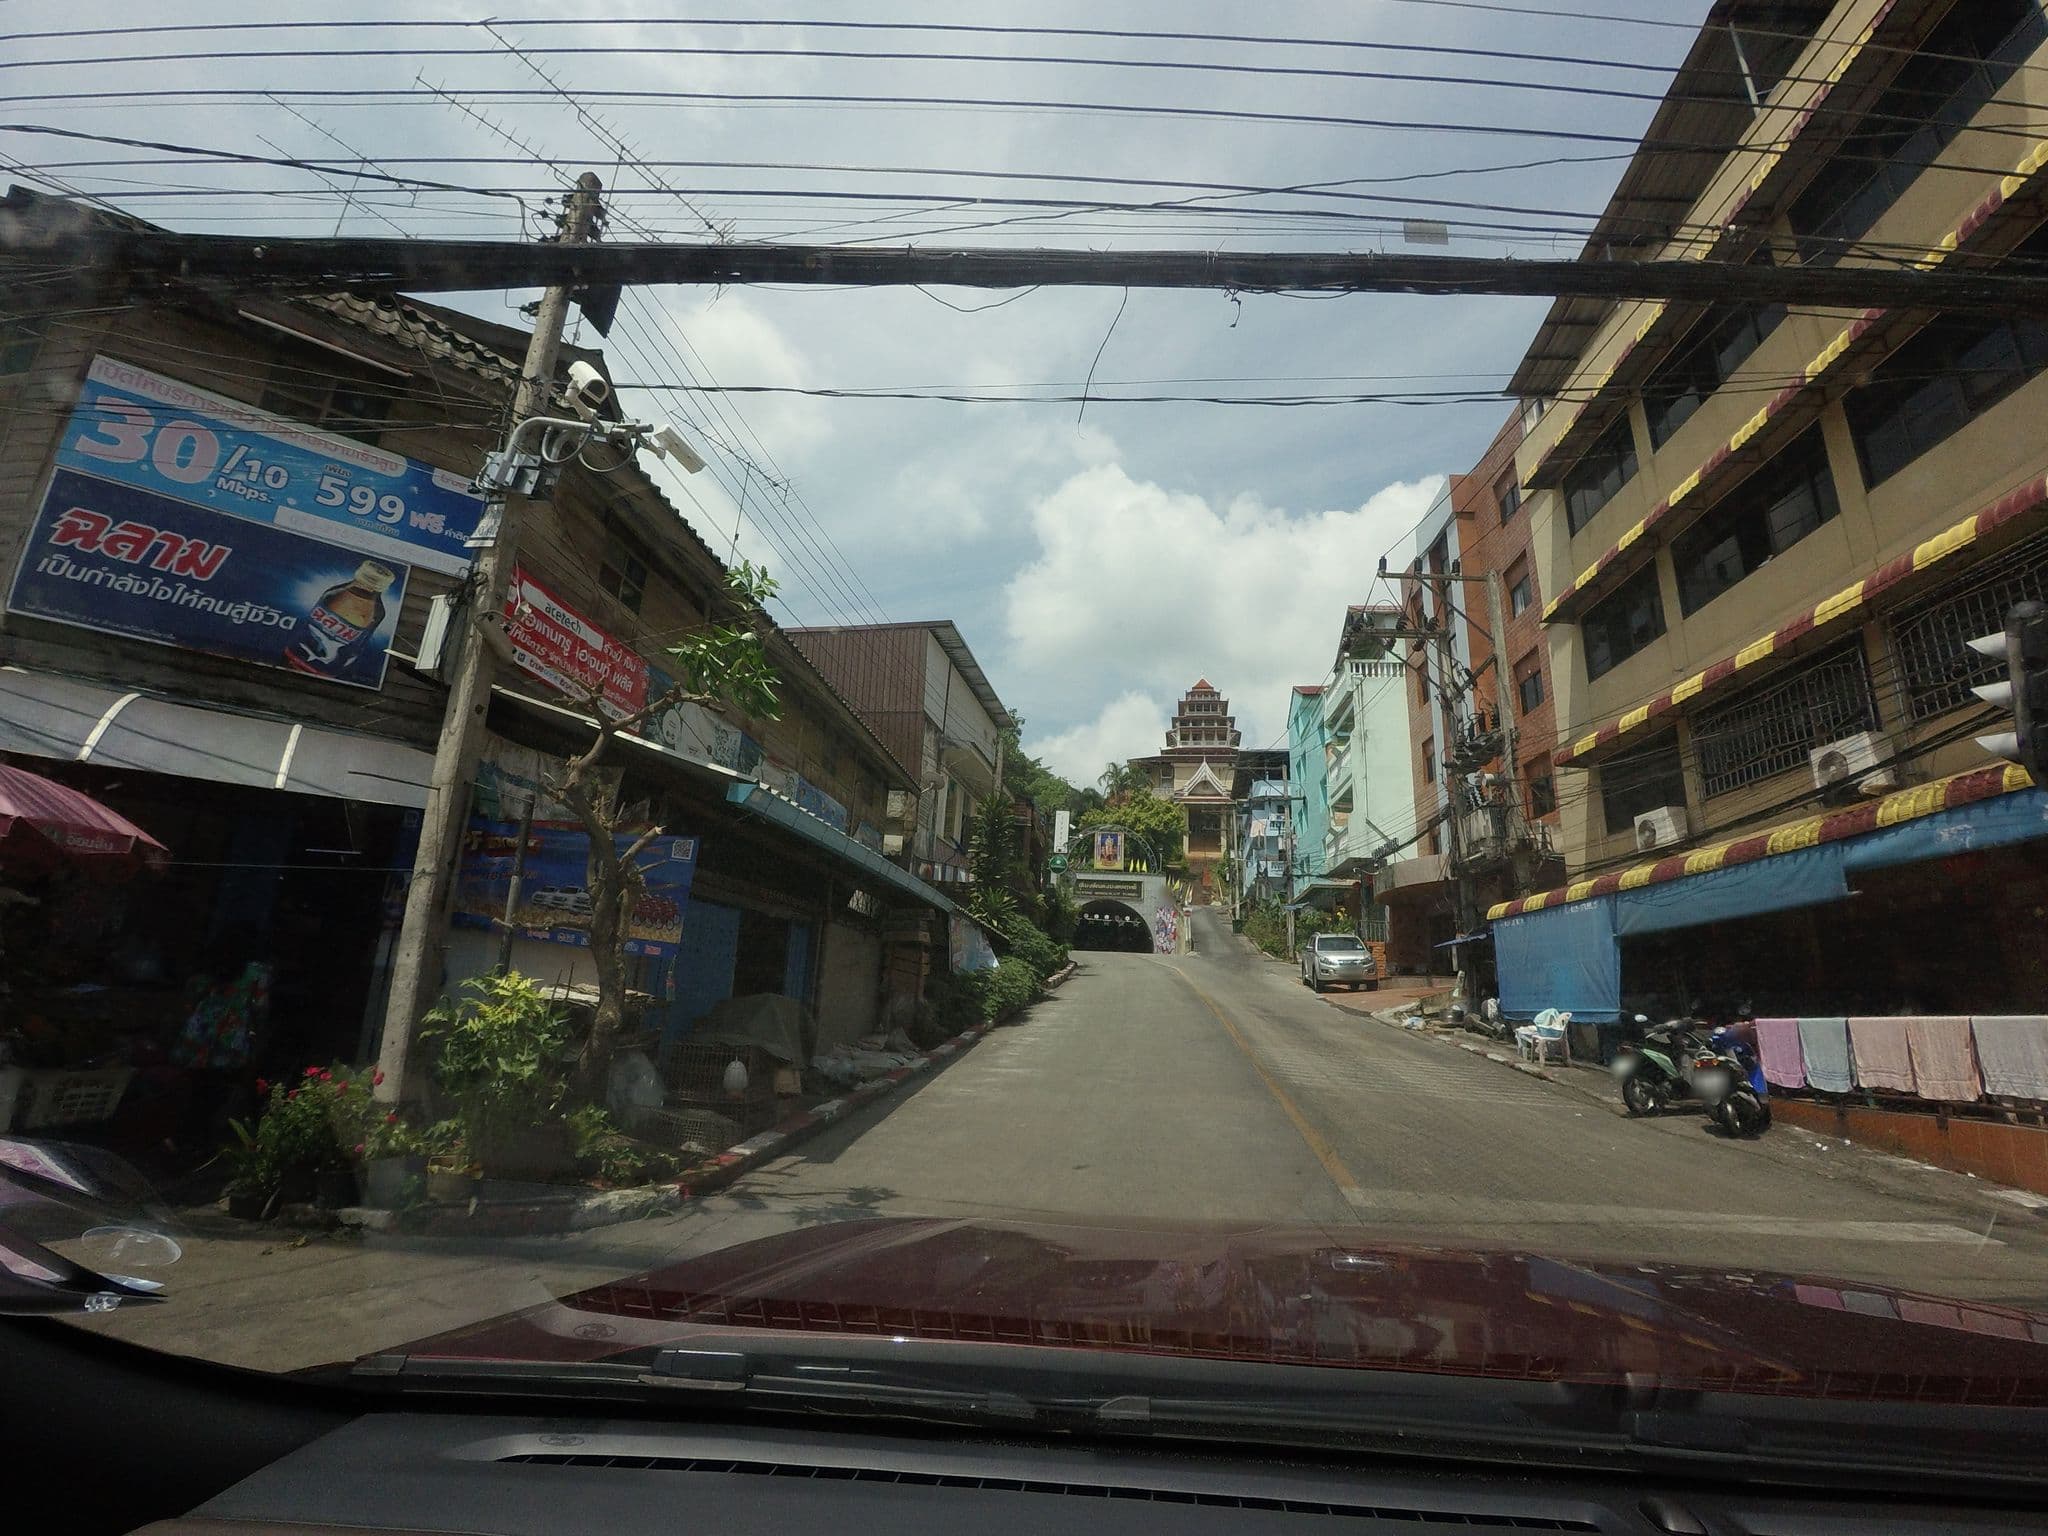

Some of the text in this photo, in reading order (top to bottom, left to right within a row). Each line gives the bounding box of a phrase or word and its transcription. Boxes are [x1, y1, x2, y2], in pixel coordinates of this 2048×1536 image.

[216, 476, 274, 504] Mbps.
[314, 475, 407, 524] 599
[409, 510, 446, 534] ฟรี
[48, 506, 233, 581] ฉลาม
[35, 554, 299, 631] เป็นกำลังใจให้คนสู้ชีวิต
[310, 606, 363, 641] ฉลาม
[545, 601, 582, 635] acetech
